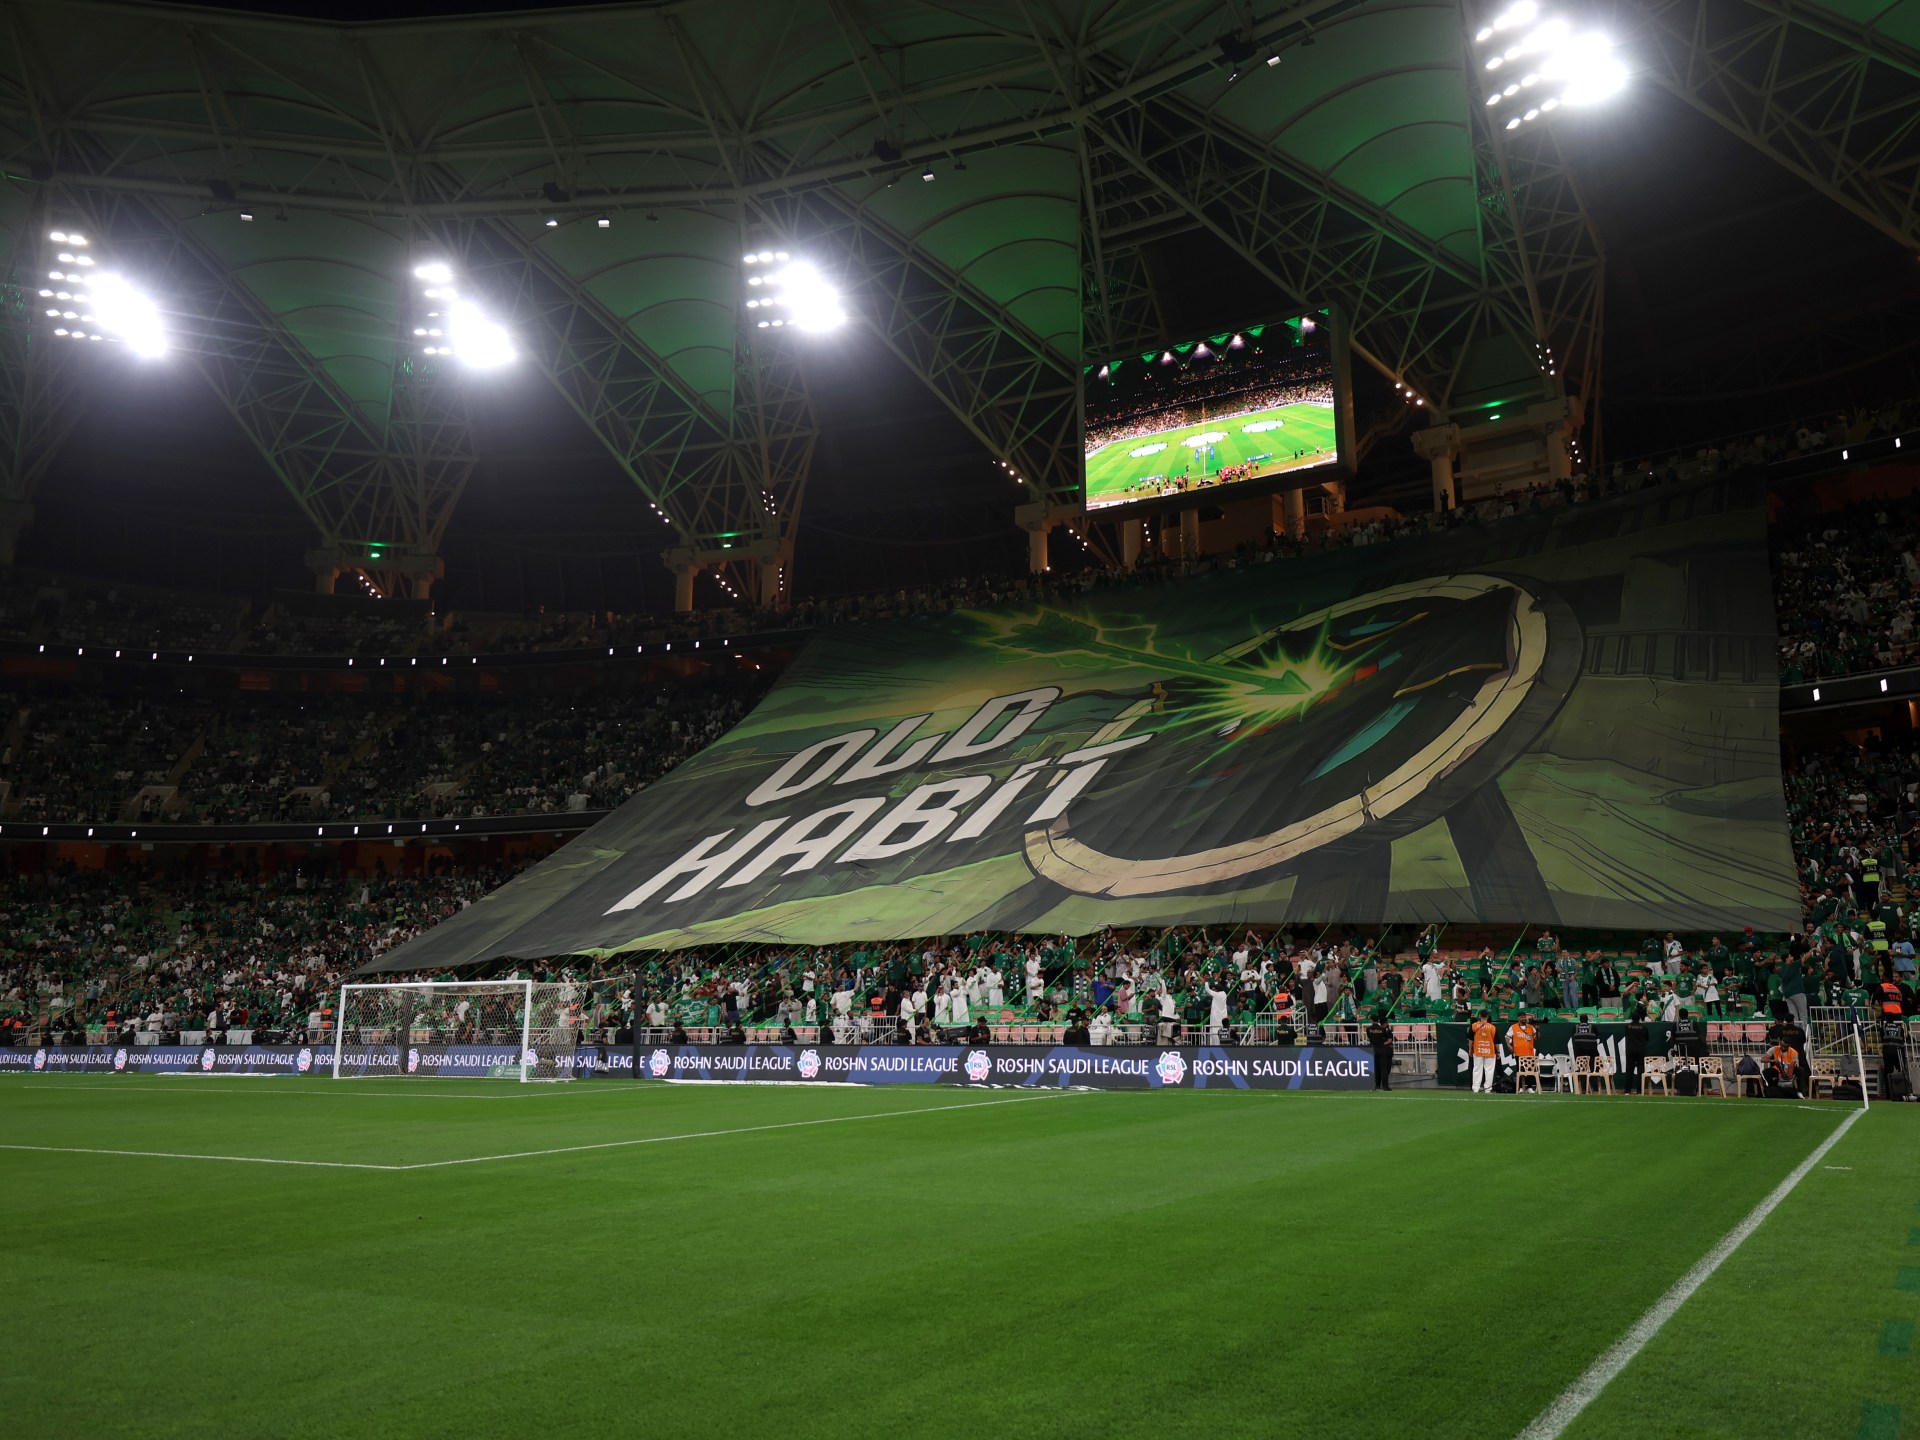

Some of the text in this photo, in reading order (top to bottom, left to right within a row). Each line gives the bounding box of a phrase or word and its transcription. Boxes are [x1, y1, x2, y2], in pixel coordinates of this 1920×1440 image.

[746, 687, 1061, 806] OLD
[602, 733, 1153, 916] HABIT
[1851, 997, 1858, 1006] 7
[0, 1055, 10, 1063] UDI
[47, 1054, 112, 1063] ROSHN SAUDI LEAGUE
[129, 1054, 198, 1064] ROSHN SAUDI LEAGUE
[218, 1054, 294, 1064] ROSHN SAUDI LEAGUE
[315, 1055, 399, 1065] ROSH SAUDI LEAGUE
[422, 1055, 452, 1065] ROSHN
[454, 1055, 480, 1066] SAUDI
[555, 1056, 645, 1068] SHN SAU LEAGE
[674, 1057, 791, 1069] ROSHN SAUDI LEAGUE
[826, 1057, 958, 1071] ROSHN SAUDI LEAGUE
[997, 1059, 1149, 1074] ROSHN SAUDI LEAGUE
[1193, 1060, 1369, 1076] ROSHN SAUDI LEAGUE
